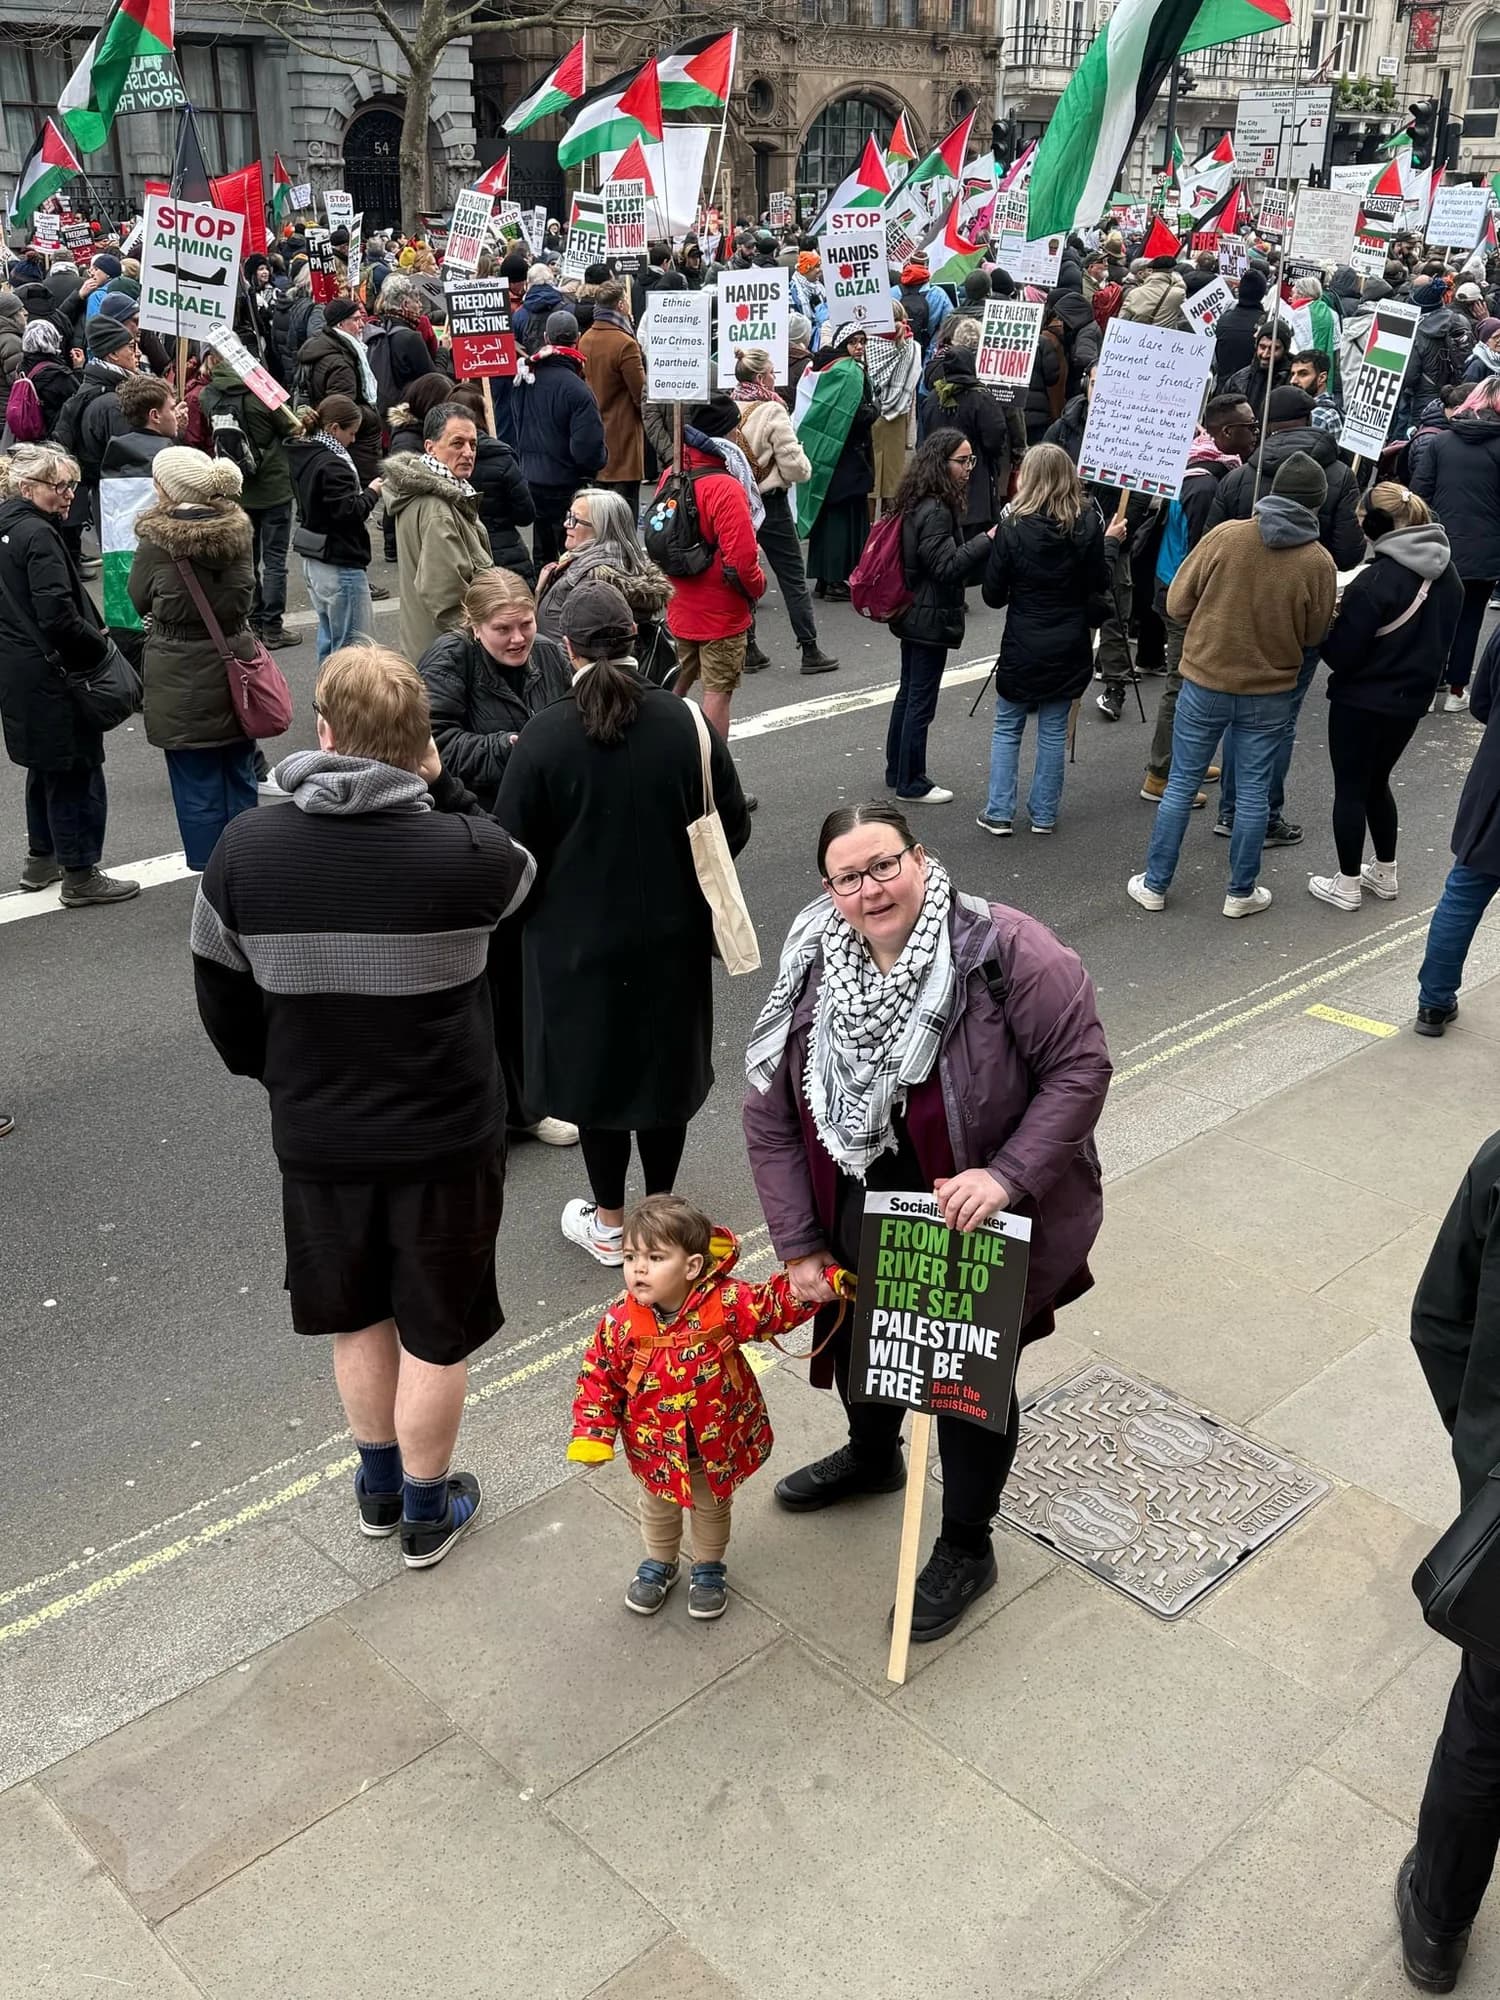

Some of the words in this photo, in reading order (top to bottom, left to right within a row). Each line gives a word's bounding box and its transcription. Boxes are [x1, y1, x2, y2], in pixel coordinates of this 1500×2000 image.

[374, 142, 389, 155] 54
[606, 184, 618, 198] FREE
[619, 182, 643, 197] PALESTINE
[606, 198, 644, 212] EXIST!
[1366, 200, 1402, 213] CEASEFIRE
[157, 206, 236, 241] STOP
[456, 208, 487, 228] EXIST!
[493, 212, 518, 226] STOP
[607, 212, 644, 224] RESIST!
[832, 213, 881, 228] STOP
[454, 222, 484, 238] RESIST!
[608, 224, 645, 248] RETURN!
[154, 232, 234, 262] ARMING
[447, 234, 481, 264] RETURN!
[569, 229, 606, 256] FREE
[1353, 246, 1386, 258] PALESTINE
[567, 249, 605, 264] PALESTINE
[827, 244, 879, 264] HANDS
[725, 282, 780, 303] HANDS
[835, 278, 880, 297] GAZA!
[148, 287, 226, 319] ISRAEL
[452, 292, 504, 311] FREEDOM
[662, 297, 692, 307] Ethnic
[1190, 288, 1225, 319] HANDS
[654, 314, 701, 325] Cleansing.
[988, 304, 1004, 320] FREE
[1004, 305, 1039, 323] PALESTINE
[452, 315, 510, 334] PALESTINE
[728, 322, 776, 342] GAZA!
[985, 320, 1036, 338] EXIST!
[464, 338, 502, 354] الحرية
[650, 336, 667, 344] War
[668, 336, 704, 345] Crimes.
[983, 336, 1033, 352] RESIST!
[1108, 324, 1132, 344] How
[1139, 334, 1162, 351] dare
[1172, 341, 1184, 354] the
[1190, 344, 1207, 357] UK
[462, 352, 509, 370] لفلسطين
[653, 358, 700, 368] Apartheid.
[978, 348, 1031, 378] RETURN!
[1155, 360, 1176, 370] call
[1102, 366, 1130, 378] Israel
[654, 379, 699, 389] Genocide.
[1353, 365, 1401, 410] FREE
[1090, 406, 1106, 416] from
[1110, 410, 1132, 420] Israel
[1137, 416, 1154, 424] until
[1160, 418, 1176, 428] there
[1168, 407, 1192, 418] divest
[1346, 400, 1390, 428] PALESTINE
[1086, 432, 1099, 440] and
[1134, 424, 1164, 438] Palestine
[1167, 430, 1188, 442] State
[1083, 454, 1100, 466] their
[1102, 461, 1127, 472] violent
[1095, 444, 1105, 453] the
[1109, 446, 1133, 459] Middle
[1138, 452, 1153, 461] East
[1156, 457, 1174, 467] from
[880, 1219, 949, 1257] FROM
[960, 1231, 1006, 1267] THE
[876, 1249, 948, 1288] RIVER
[957, 1262, 988, 1293] TO
[875, 1279, 921, 1312] THE
[927, 1288, 973, 1322] SEA
[871, 1309, 1001, 1360] PALESTINE
[869, 1338, 925, 1376] WILL
[932, 1352, 966, 1381] BE
[865, 1368, 924, 1406] FREE
[932, 1381, 959, 1396] Back
[962, 1386, 980, 1402] the
[930, 1398, 988, 1420] resistance
[1076, 1492, 1134, 1532] Thames
[1237, 1489, 1299, 1536] STANTON
[1062, 1507, 1107, 1537] Water
